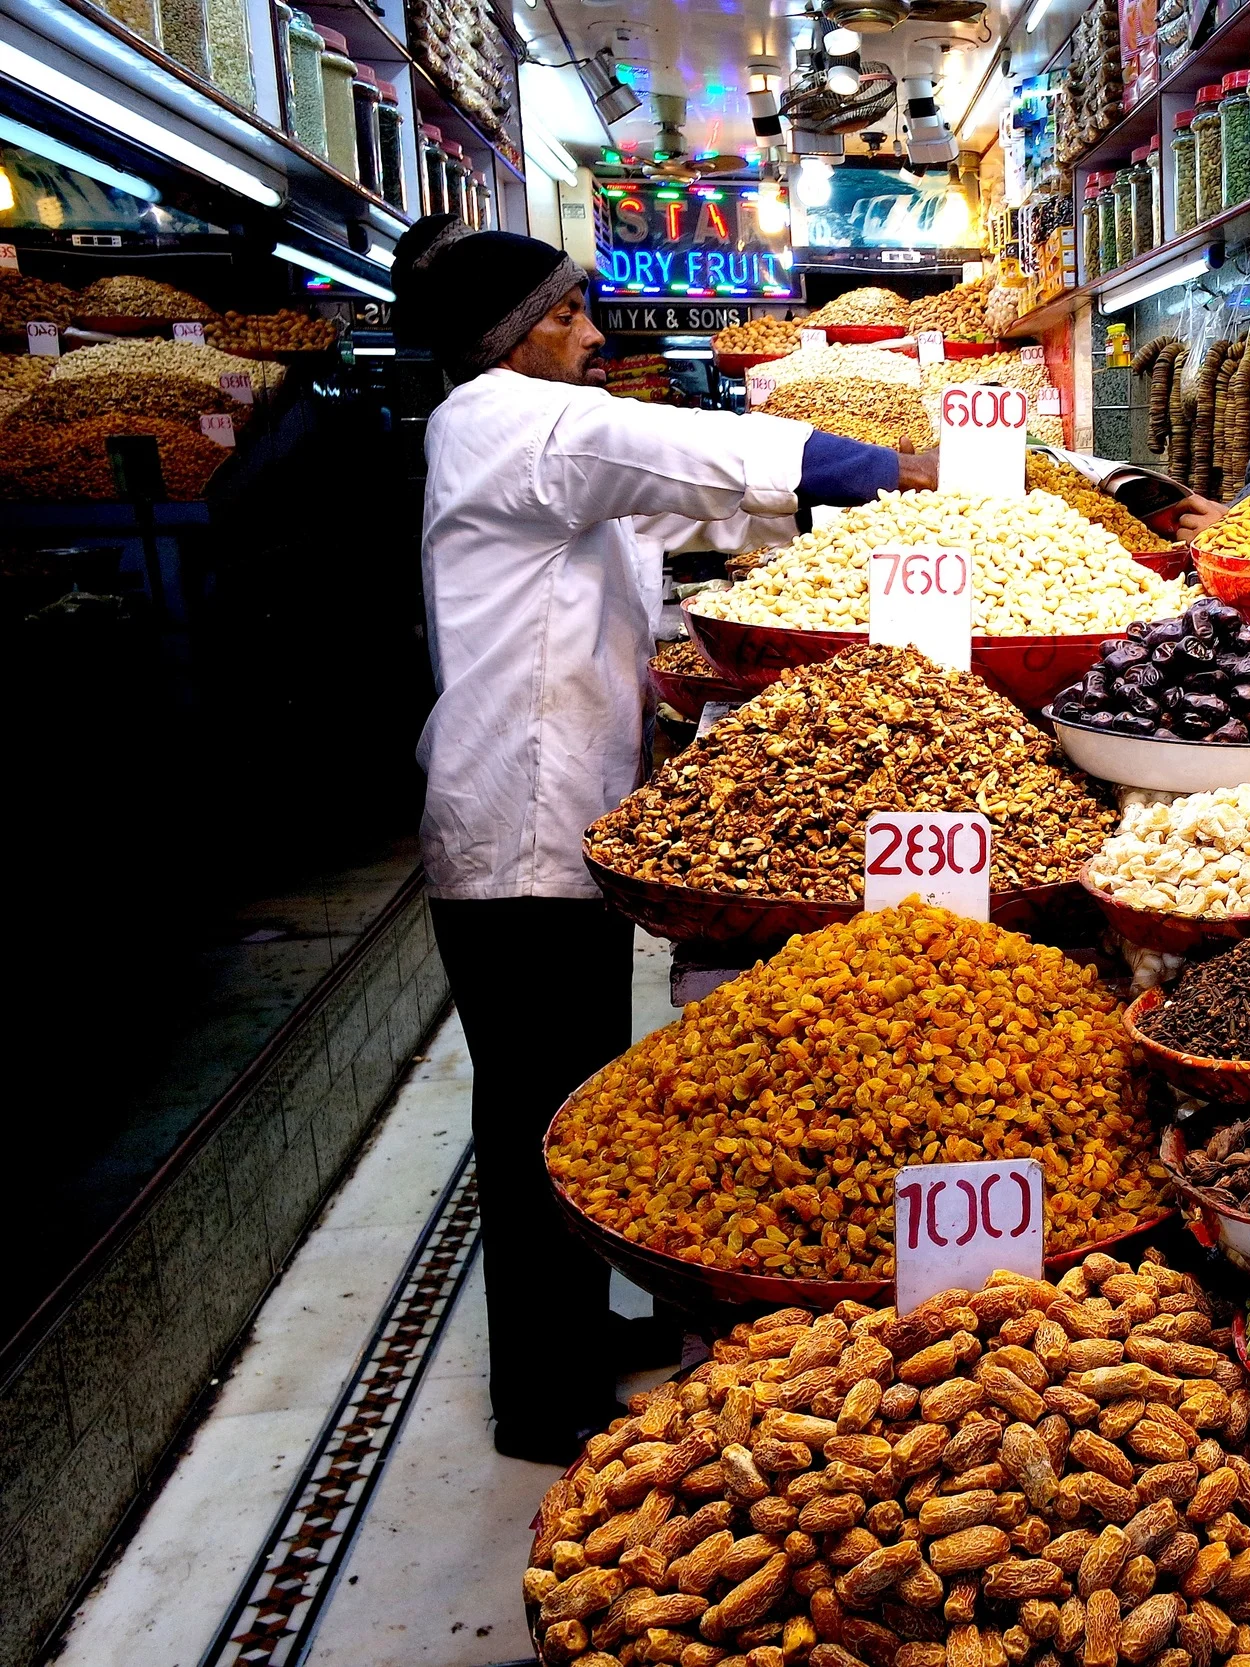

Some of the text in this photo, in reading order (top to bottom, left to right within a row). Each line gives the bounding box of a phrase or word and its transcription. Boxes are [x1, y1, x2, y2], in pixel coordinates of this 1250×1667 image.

[613, 251, 778, 284] DRY FRUIT
[666, 308, 679, 328] &
[689, 308, 740, 328] SONS
[918, 331, 942, 345] 640
[1021, 347, 1044, 361] 1000
[752, 377, 777, 391] 1180
[942, 389, 1027, 428] 600
[872, 553, 967, 596] 760
[866, 822, 988, 877] 280
[898, 1172, 1032, 1250] 100
